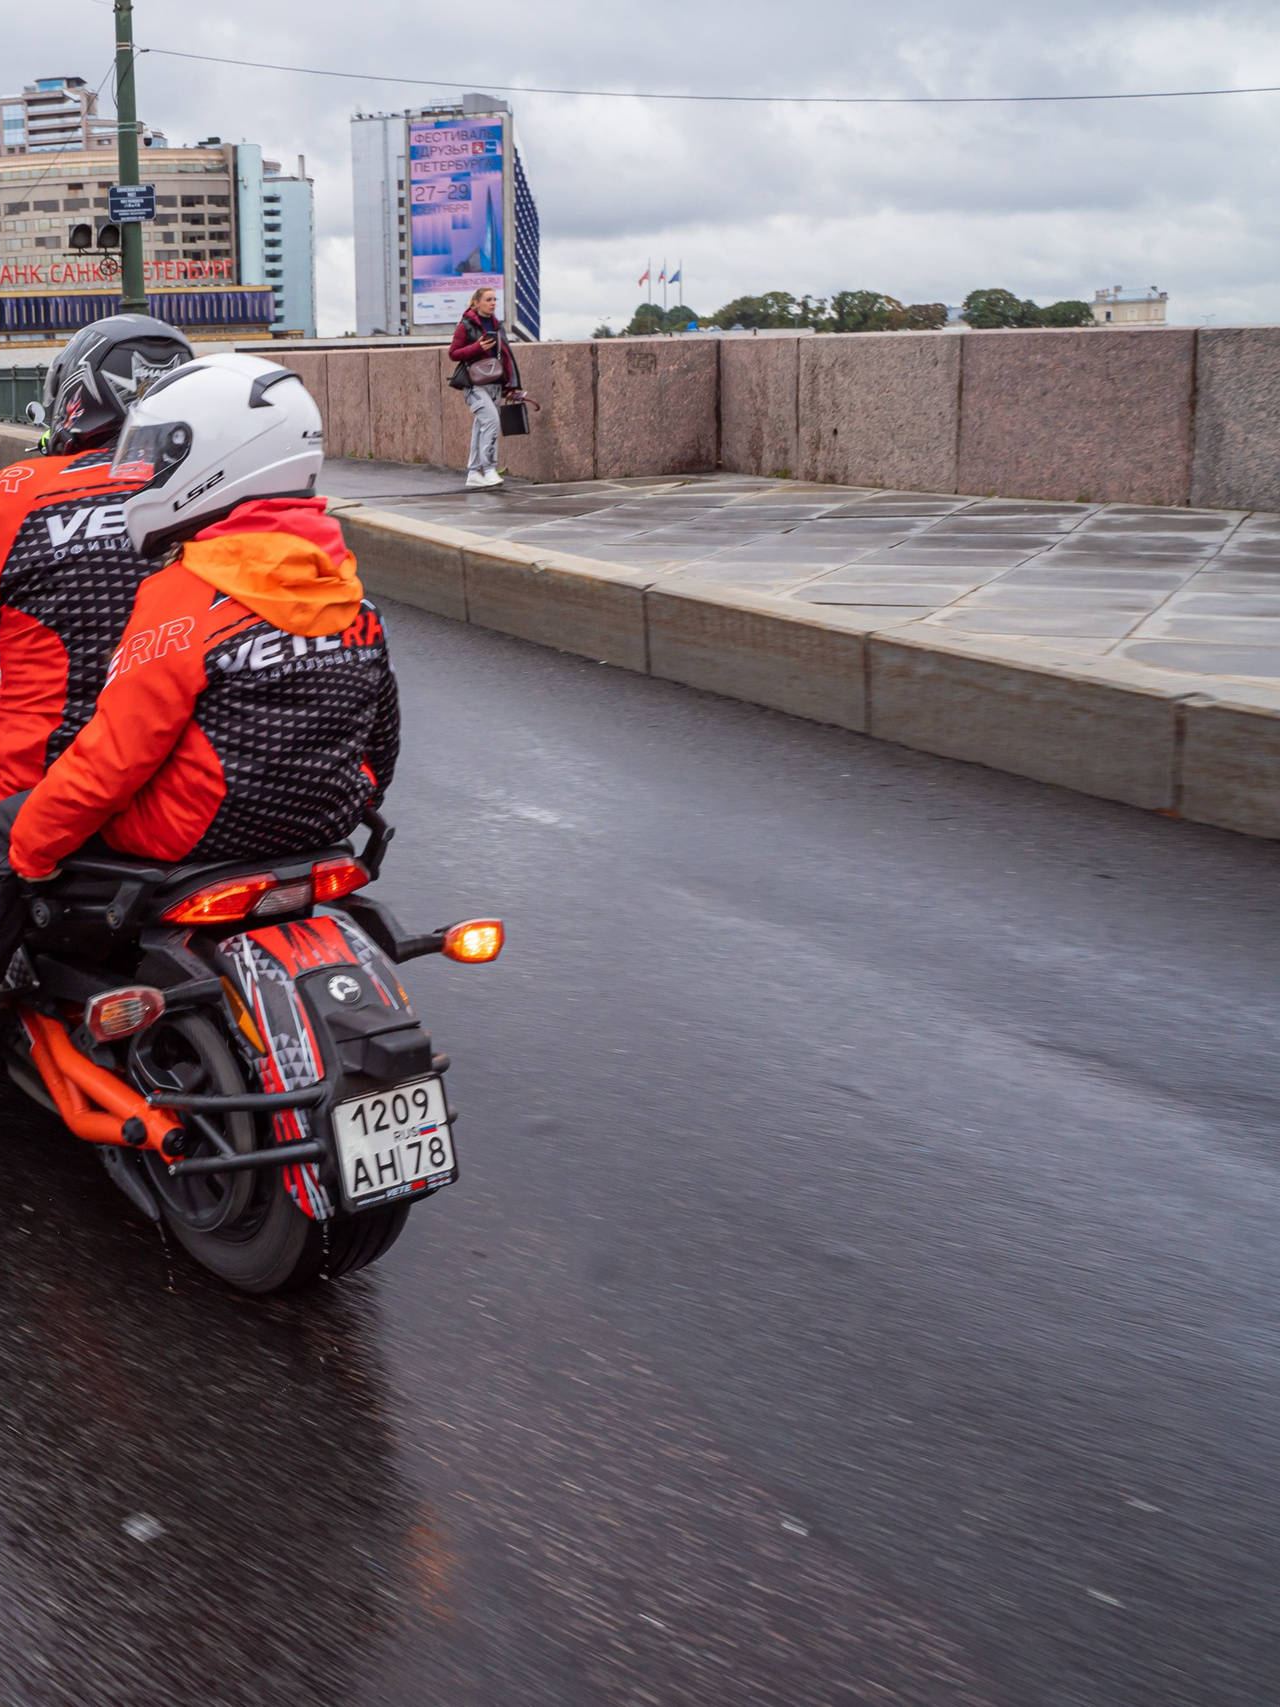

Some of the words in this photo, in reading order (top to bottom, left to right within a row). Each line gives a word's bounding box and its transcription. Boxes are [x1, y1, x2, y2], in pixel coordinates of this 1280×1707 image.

[414, 129, 495, 143] ФЕСТИВАЛЬ
[416, 203, 469, 214] СЕНТЯБРЯ
[50, 260, 234, 284] САНКТ-ЕТЕРБУРГ
[173, 469, 226, 512] LS2
[351, 1088, 428, 1136] 1209
[394, 1126, 420, 1141] RUS
[407, 1136, 446, 1174] 78
